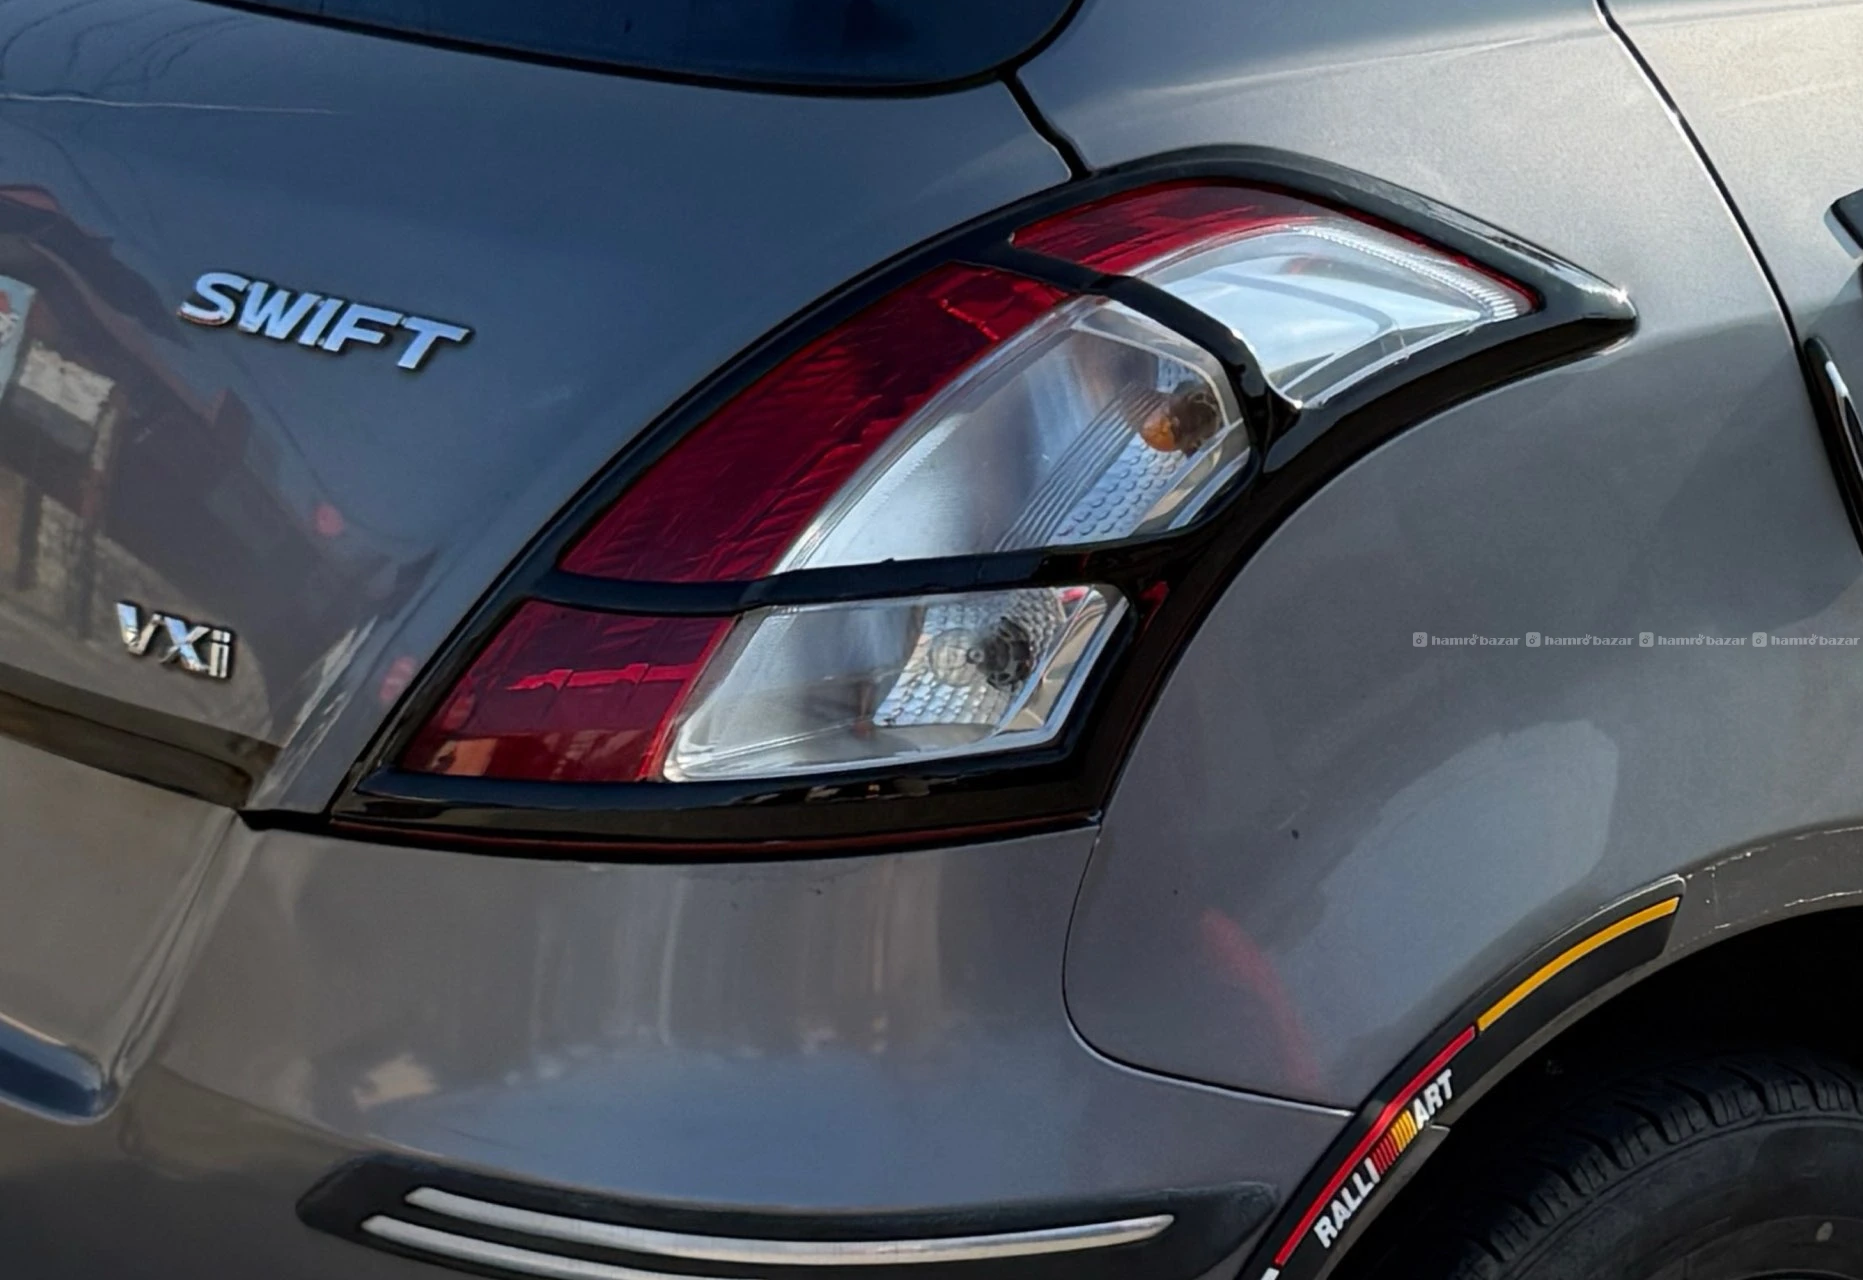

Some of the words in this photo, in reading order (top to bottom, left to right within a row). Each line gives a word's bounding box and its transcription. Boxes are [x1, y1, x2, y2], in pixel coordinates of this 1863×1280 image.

[177, 271, 471, 369] SWIFT
[115, 600, 234, 680] VXi
[1314, 1157, 1381, 1249] RALLI
[1412, 1069, 1453, 1131] ART
